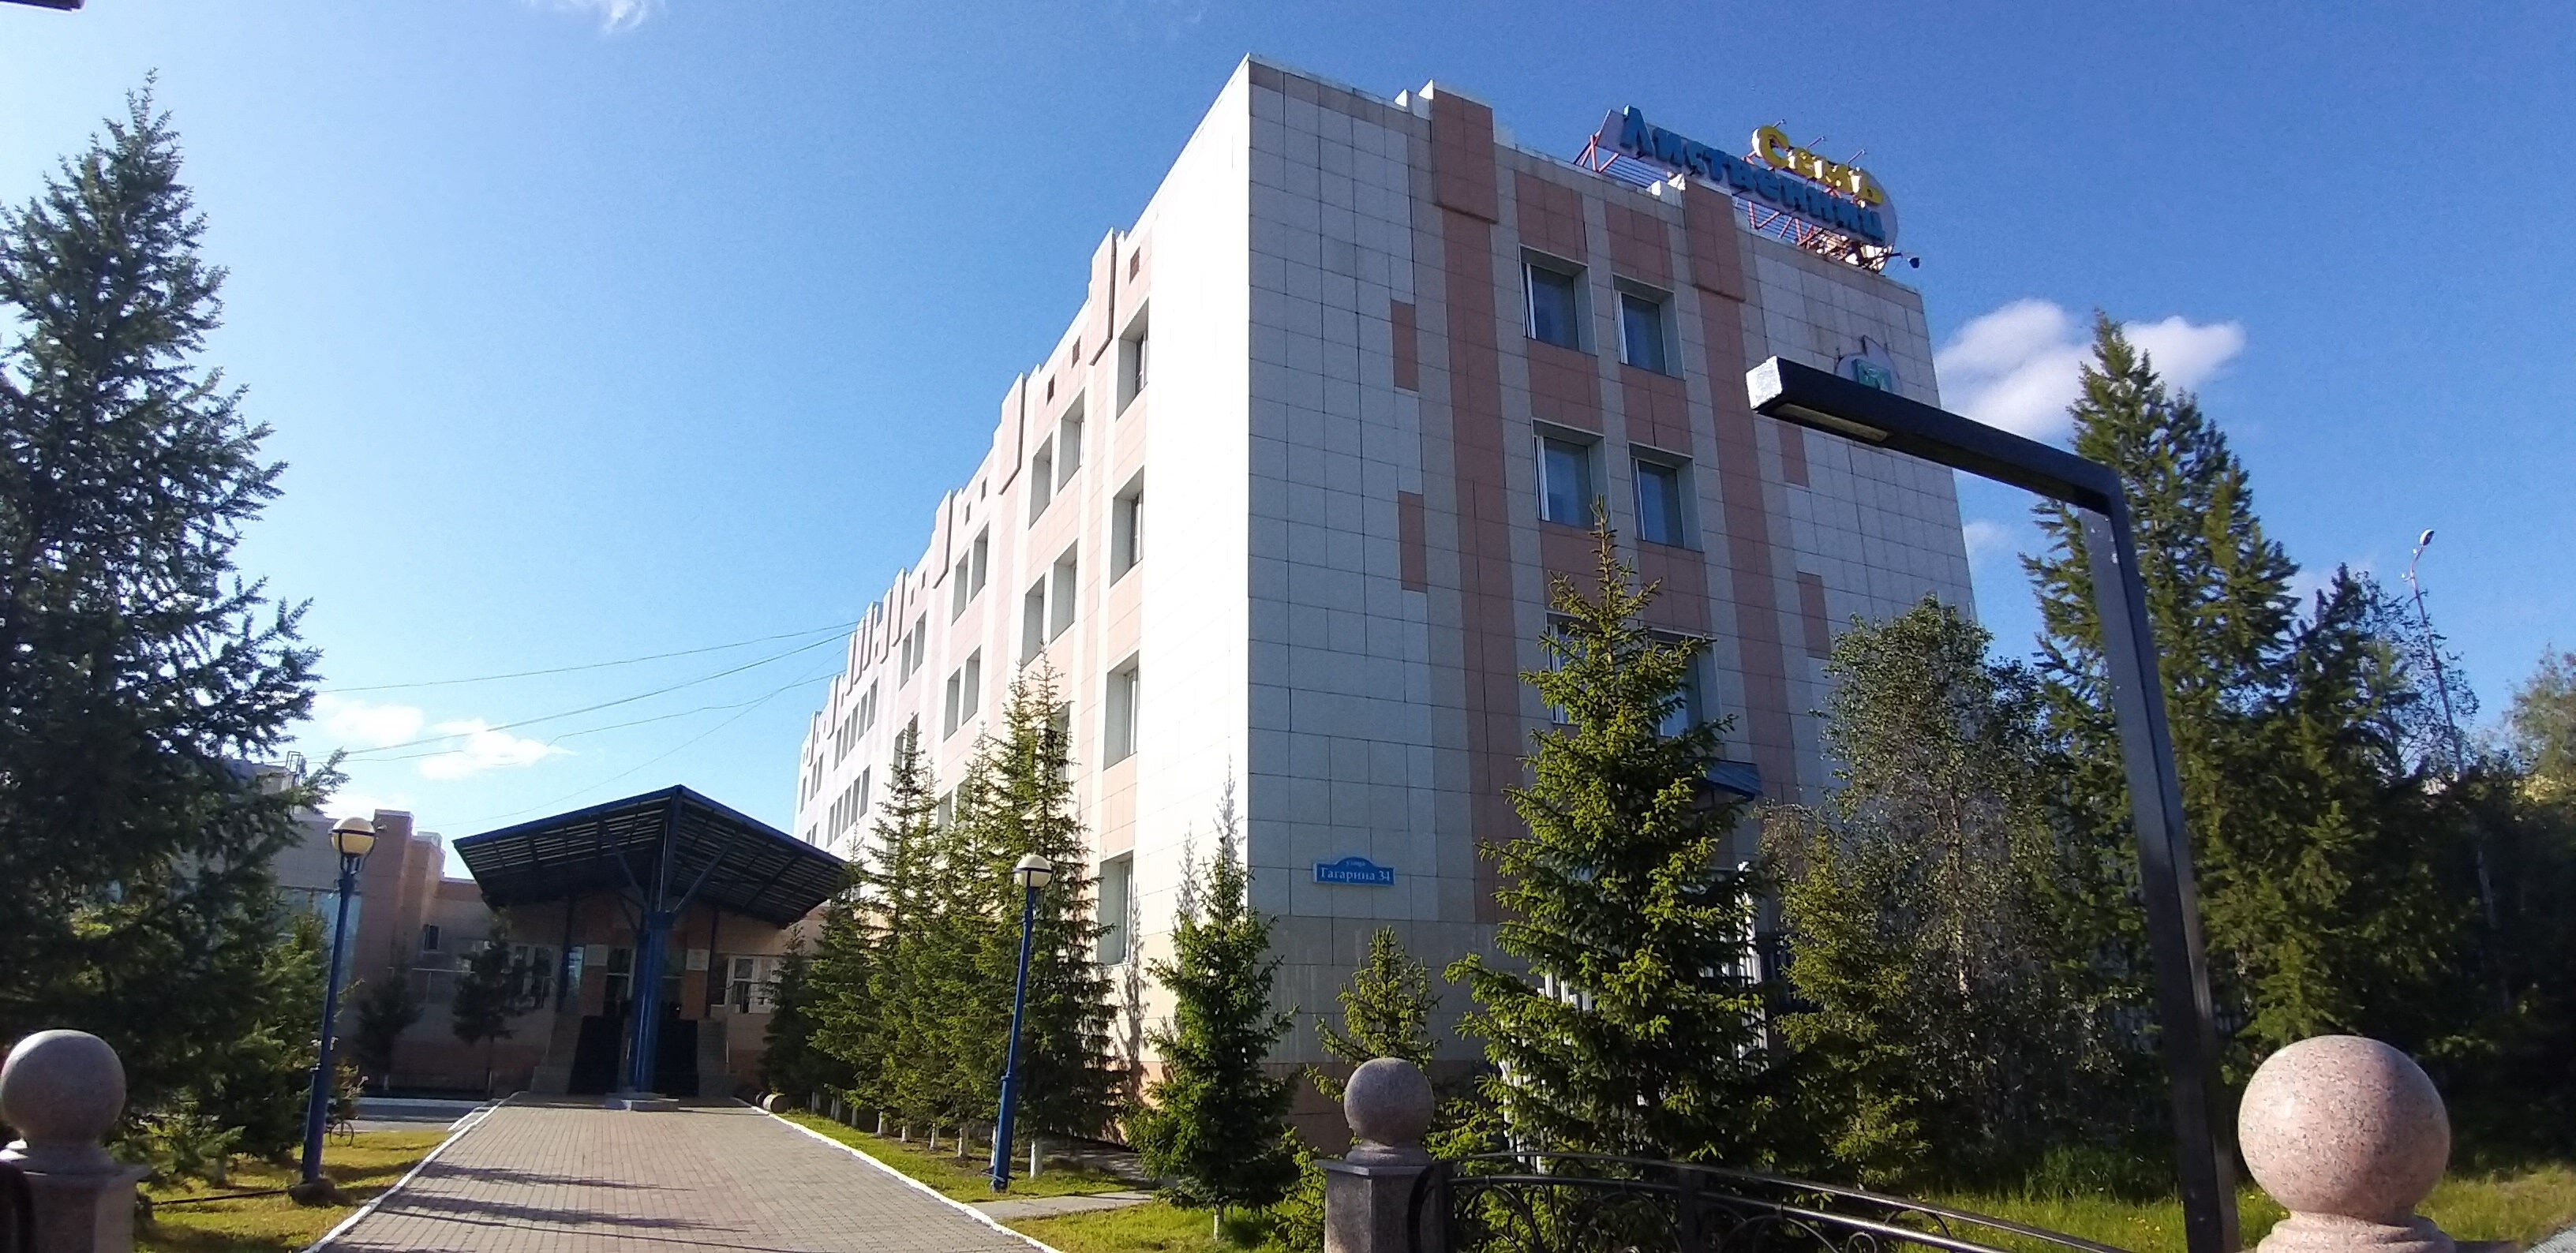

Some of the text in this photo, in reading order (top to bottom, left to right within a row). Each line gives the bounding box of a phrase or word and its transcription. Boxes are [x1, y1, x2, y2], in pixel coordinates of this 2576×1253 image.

[1619, 105, 1886, 245] Лиственниц
[1751, 125, 1883, 205] Семь
[1320, 866, 1390, 882] Гагарина 34
